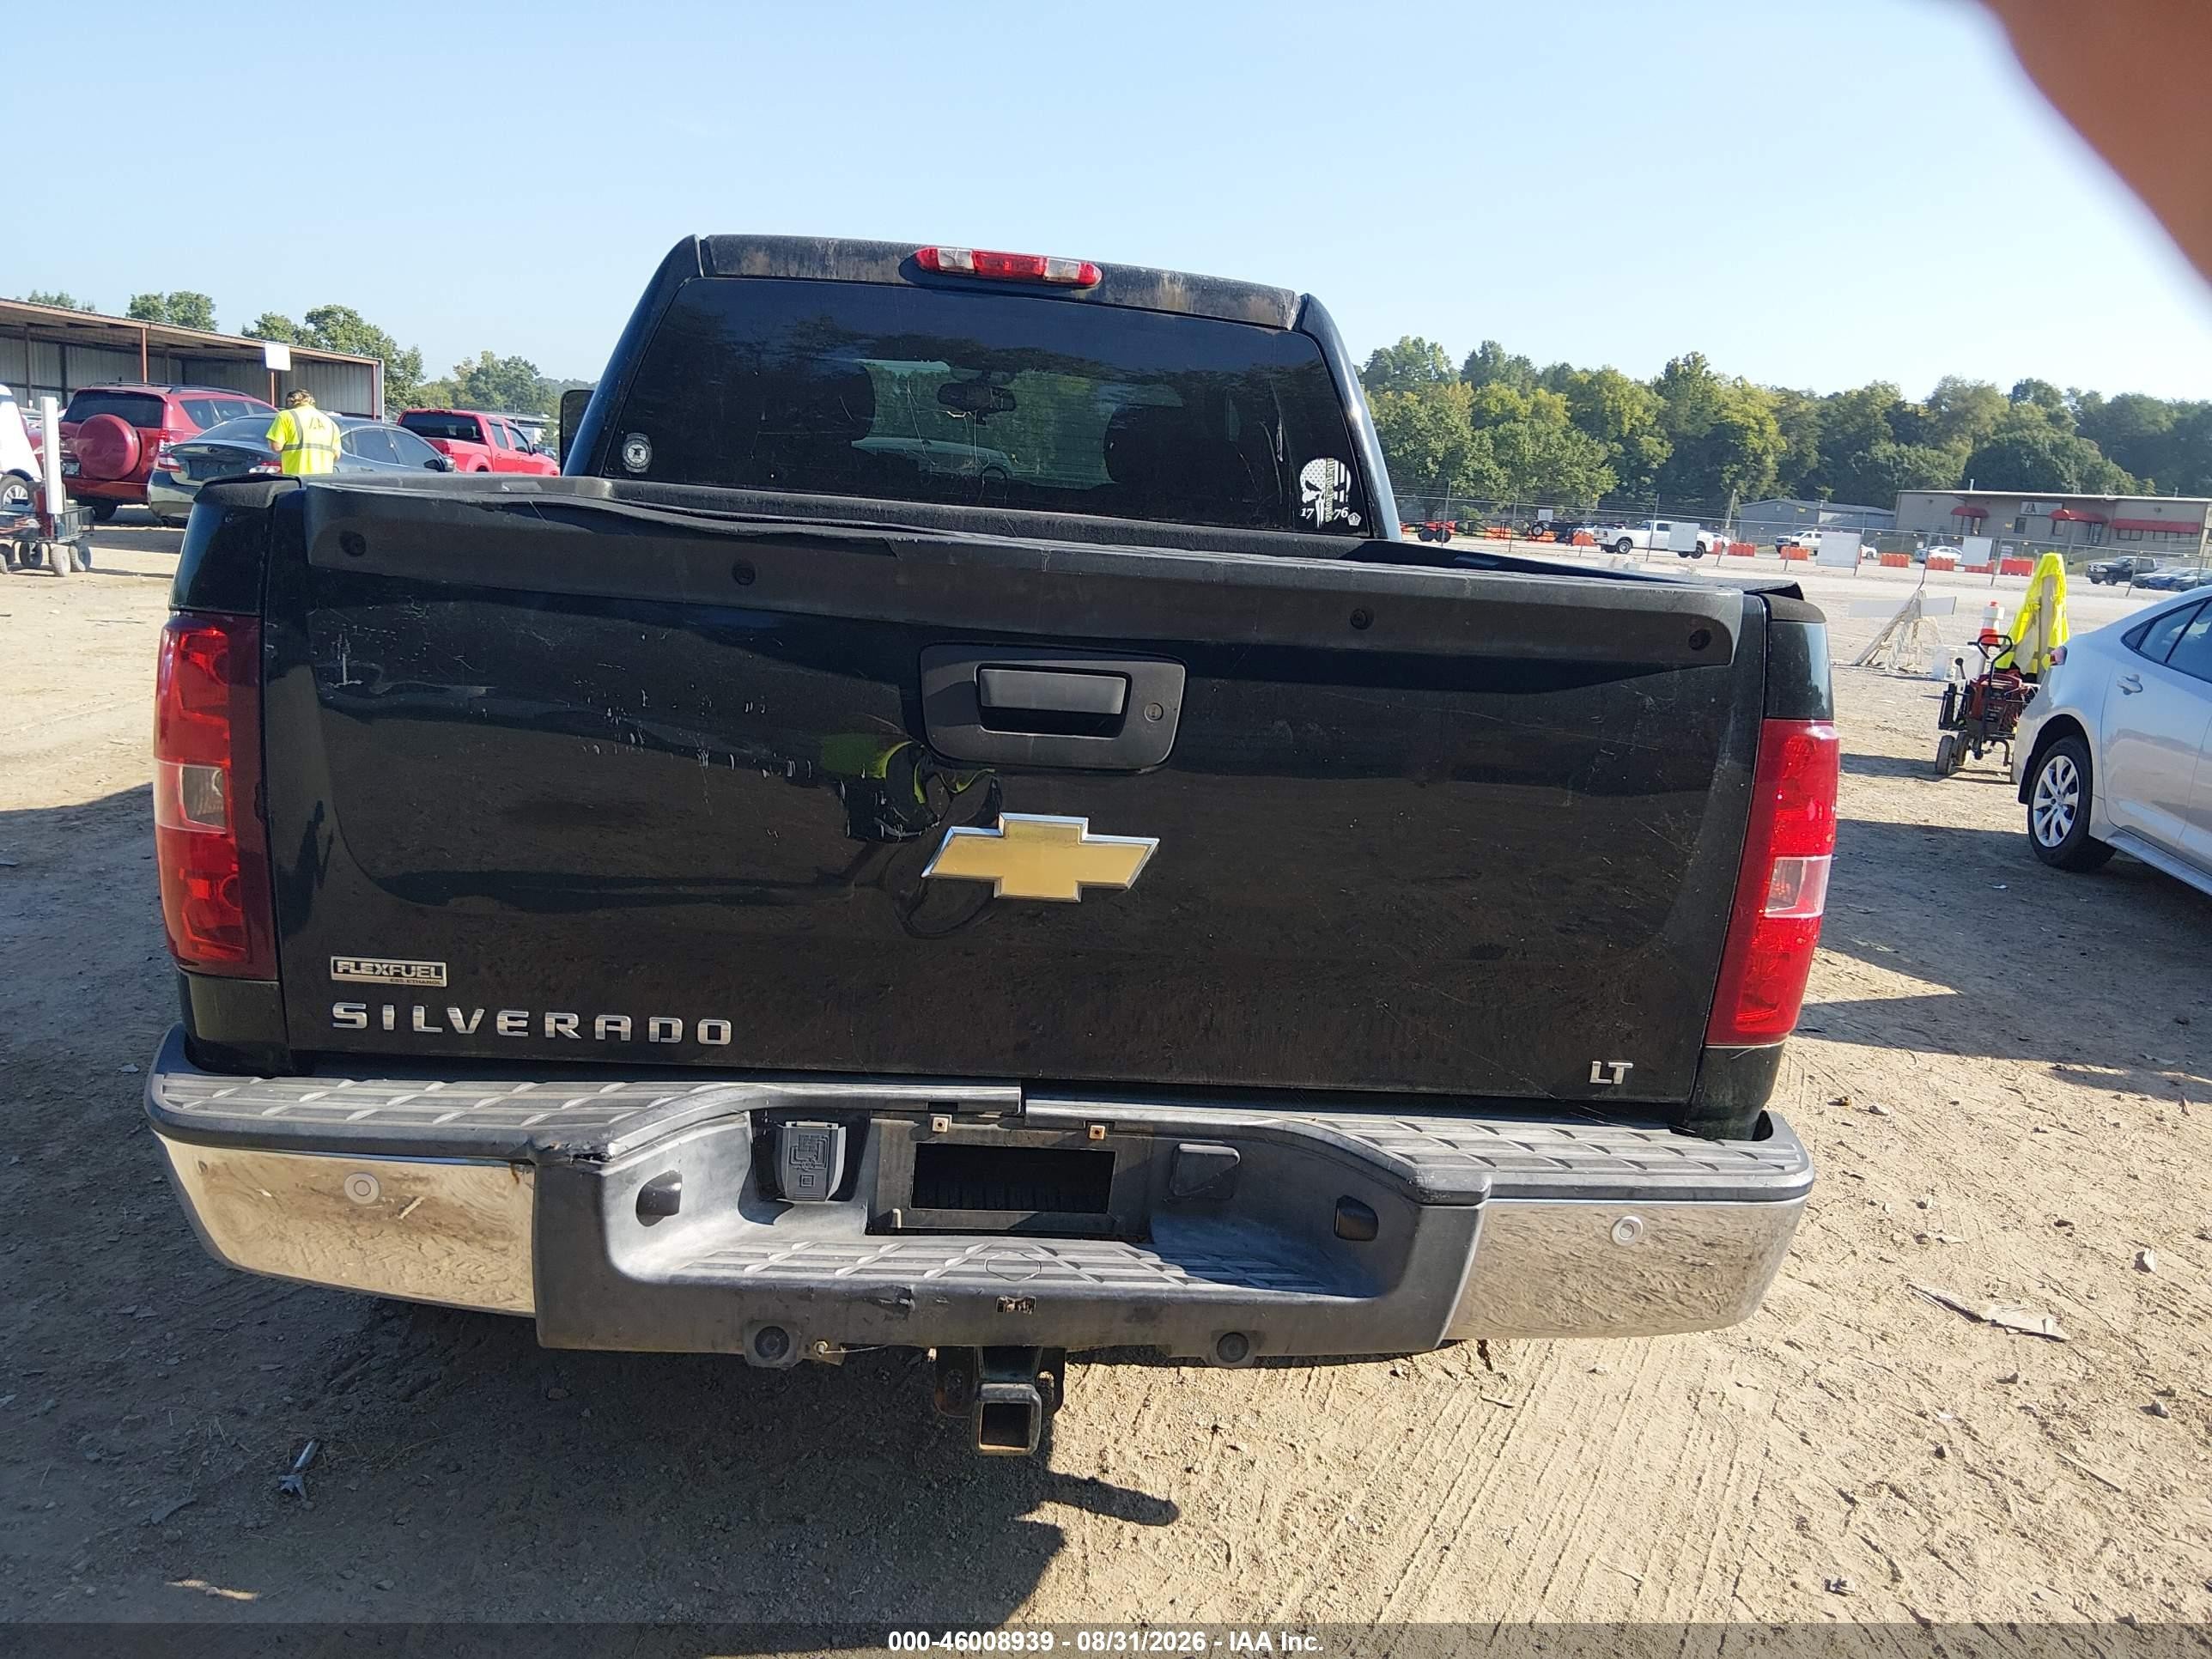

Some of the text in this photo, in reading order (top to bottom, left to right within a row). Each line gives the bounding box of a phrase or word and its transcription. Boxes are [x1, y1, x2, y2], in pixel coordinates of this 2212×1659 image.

[1300, 507, 1349, 520] 17 76
[337, 961, 442, 979] FLEXFUEL
[332, 1001, 732, 1046] SILVERADO
[1589, 1060, 1633, 1085] LT
